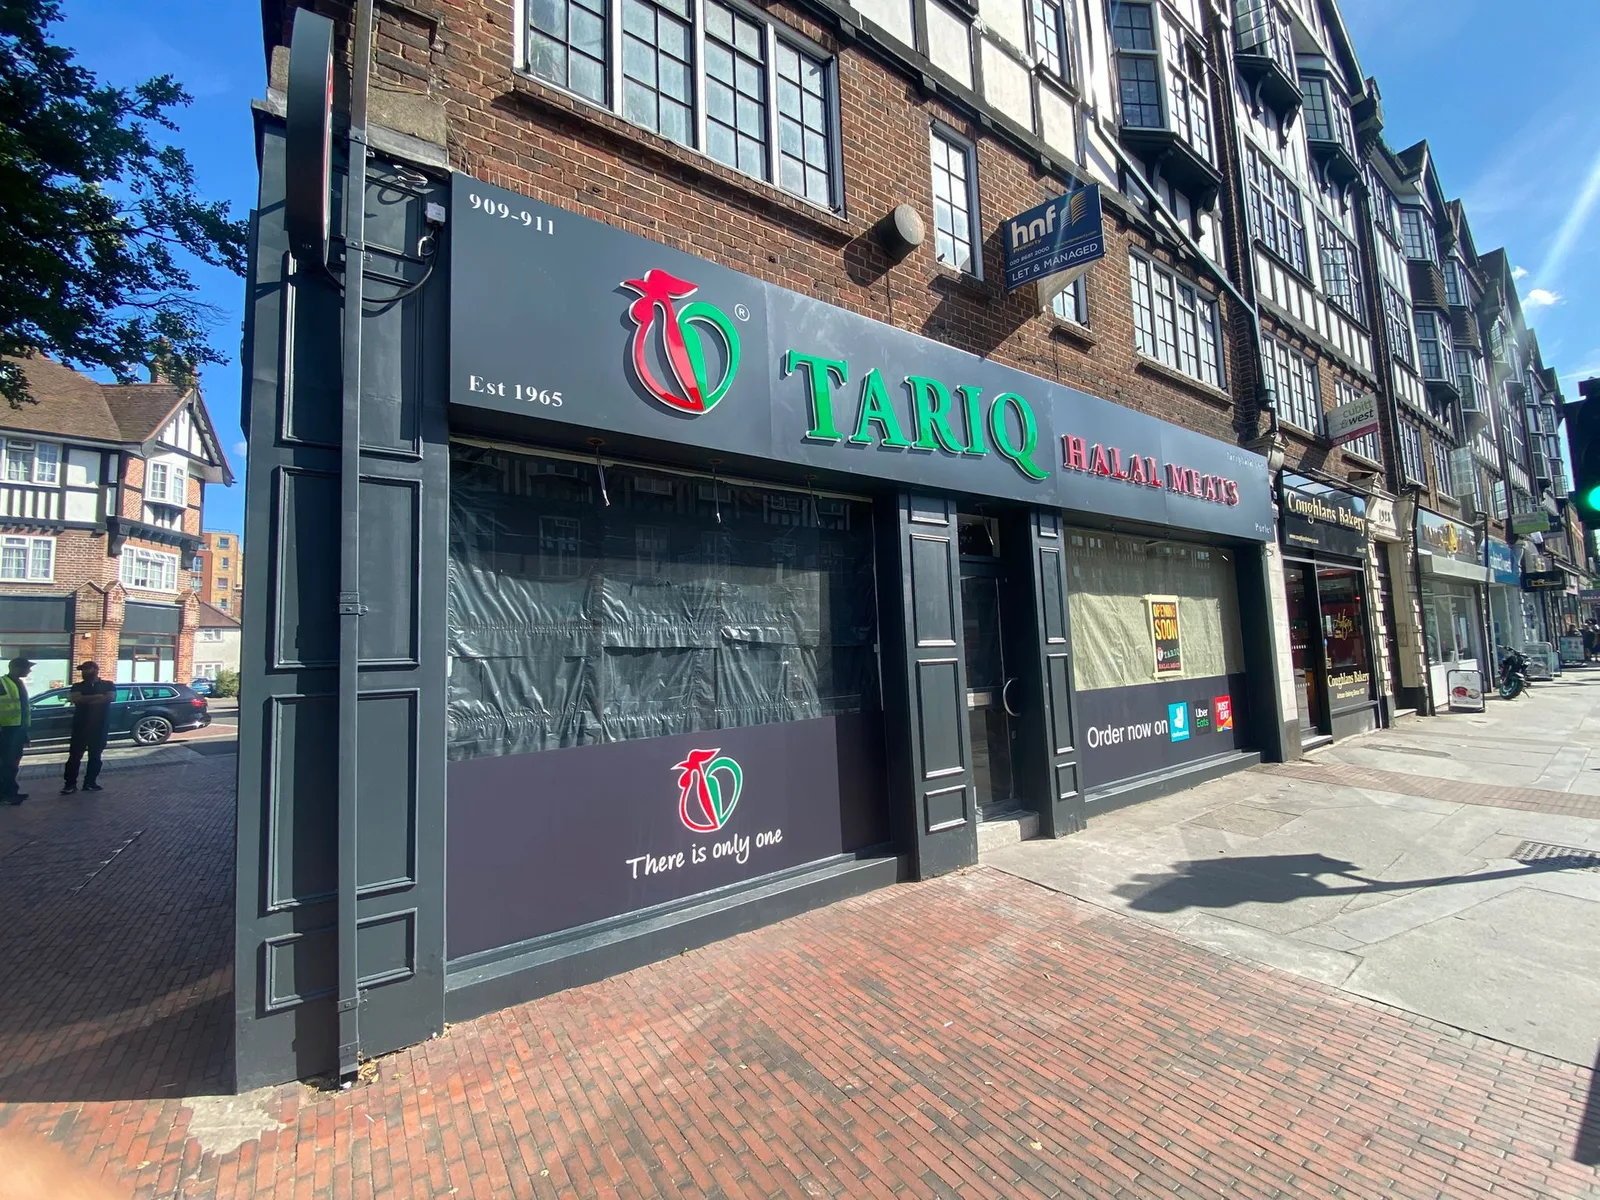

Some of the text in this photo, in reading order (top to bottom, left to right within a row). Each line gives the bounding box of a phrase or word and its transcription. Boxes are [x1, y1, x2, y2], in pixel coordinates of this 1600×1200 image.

[469, 193, 555, 235] 909-911
[1011, 204, 1057, 249] hnf
[1012, 243, 1098, 282] LET & MANAGED
[1035, 245, 1050, 256] 2000
[469, 374, 564, 408] Est 1965
[785, 349, 1051, 480] TARIQ
[1343, 399, 1373, 418] cubitt
[1348, 409, 1375, 425] west
[1061, 434, 1240, 507] HALAL MEATS
[1288, 490, 1366, 537] Coughlans Bakery
[1153, 604, 1176, 618] OPENING
[1154, 618, 1178, 640] SOON
[1195, 708, 1208, 718] Uber
[1217, 701, 1229, 712] JUST
[1220, 710, 1230, 720] EAT
[1087, 724, 1125, 749] Order
[1127, 722, 1153, 741] now
[1154, 719, 1169, 736] on
[1196, 718, 1209, 728] Eats
[626, 828, 783, 879] There is only one
